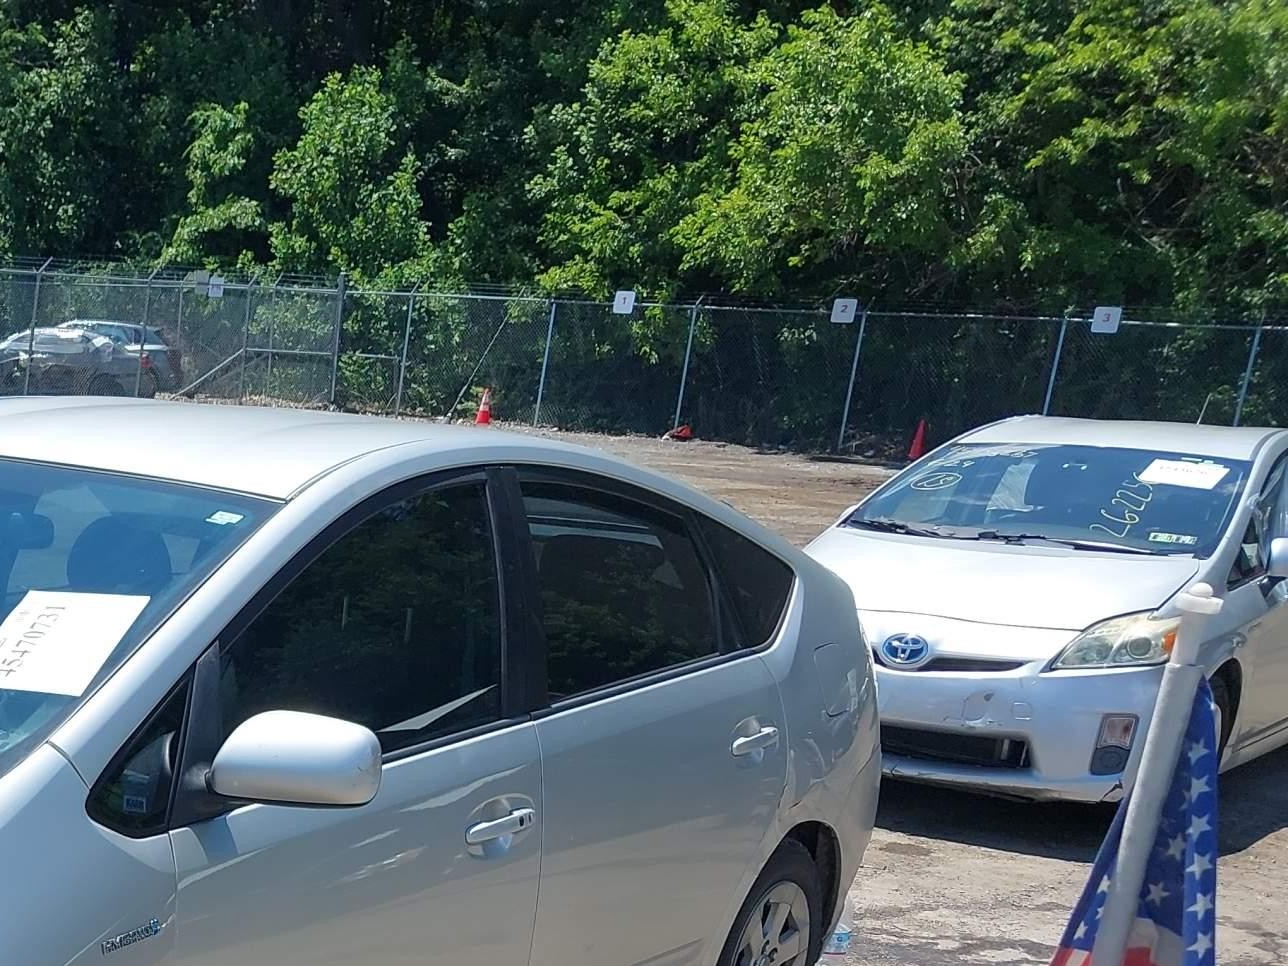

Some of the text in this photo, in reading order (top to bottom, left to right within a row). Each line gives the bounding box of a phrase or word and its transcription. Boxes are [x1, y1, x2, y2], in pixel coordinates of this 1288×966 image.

[621, 297, 628, 305] 1
[840, 304, 849, 313] 2
[1102, 313, 1111, 322] 3
